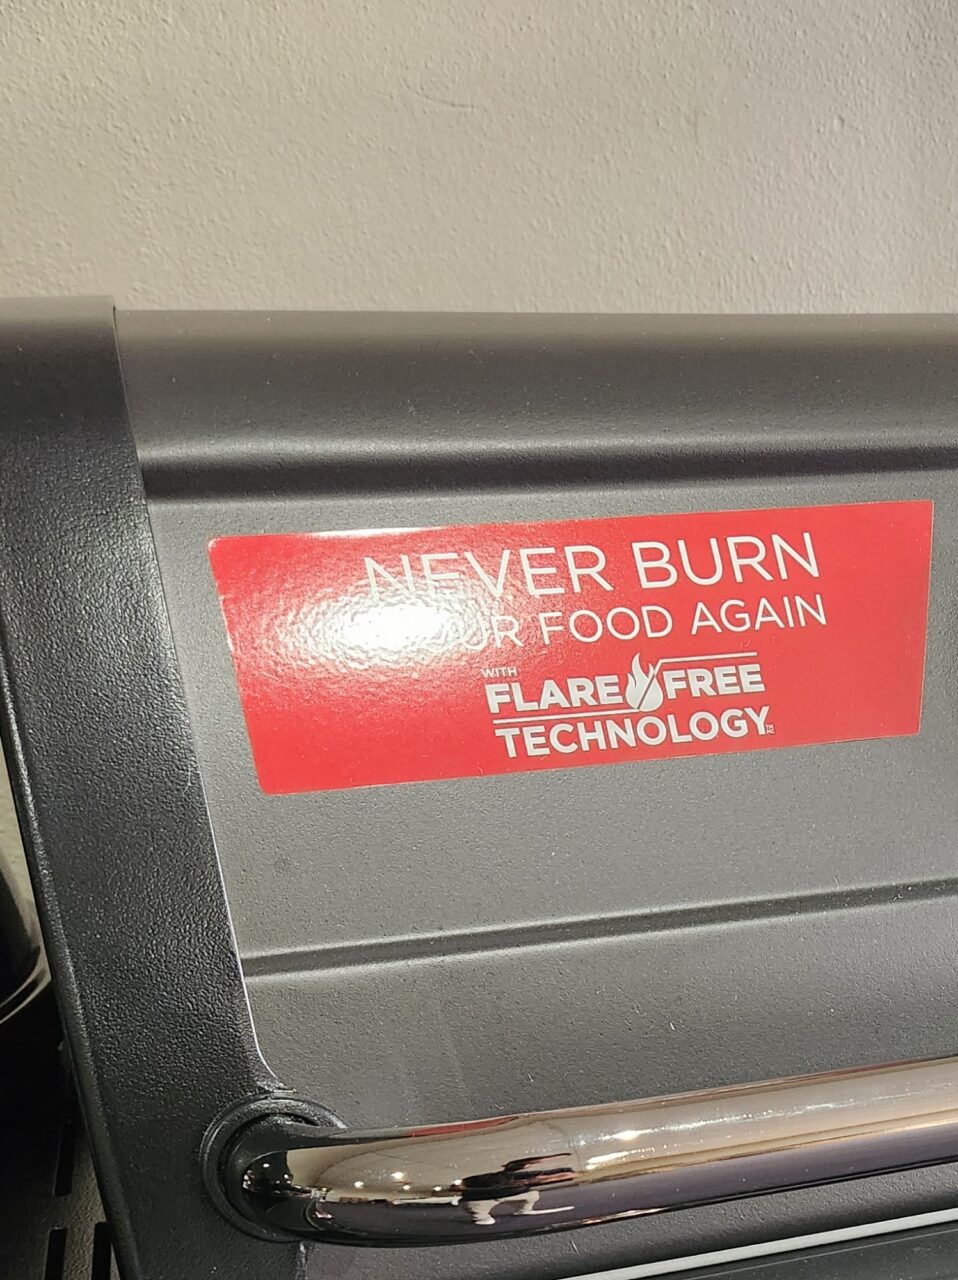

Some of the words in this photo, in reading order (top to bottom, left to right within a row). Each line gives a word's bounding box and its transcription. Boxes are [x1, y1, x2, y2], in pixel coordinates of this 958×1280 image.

[362, 545, 614, 603] NEVER
[633, 531, 820, 590] BURN
[539, 605, 672, 645] FOOD
[690, 594, 827, 634] AGAIN
[480, 666, 518, 679] WITH
[485, 681, 623, 714] FLARE
[663, 664, 765, 698] FREE
[494, 705, 771, 759] TECHNOLOGY
